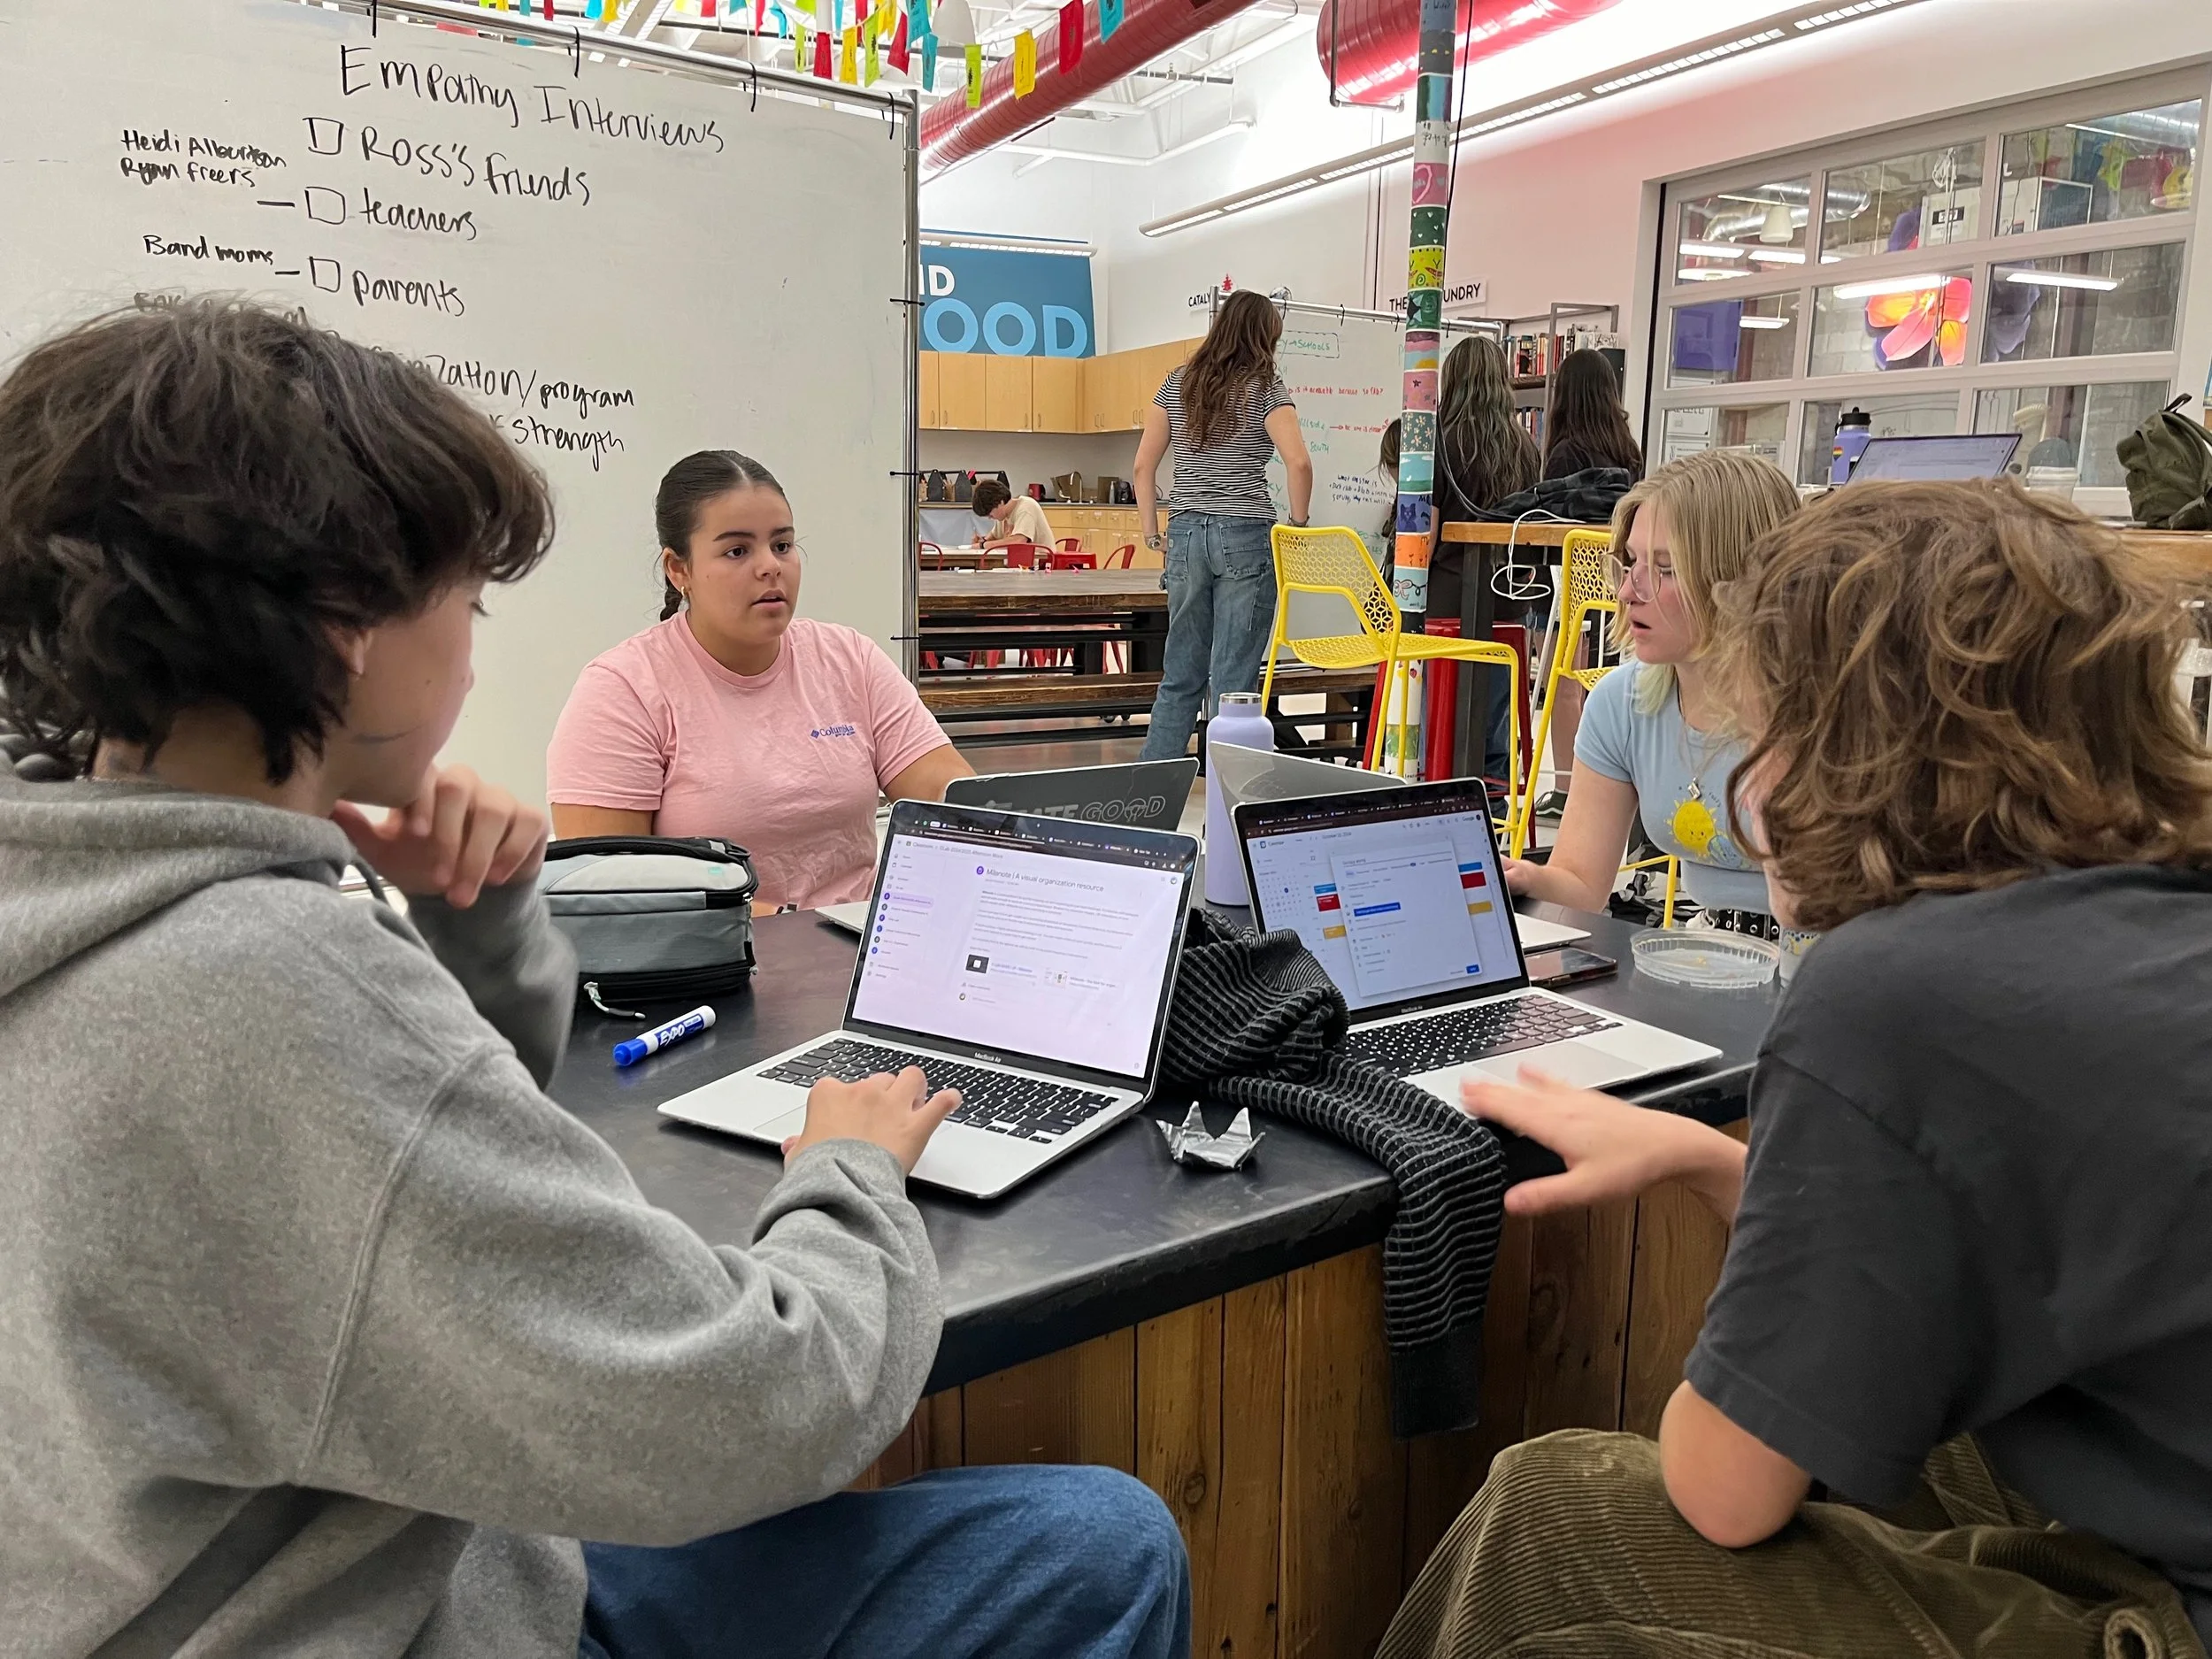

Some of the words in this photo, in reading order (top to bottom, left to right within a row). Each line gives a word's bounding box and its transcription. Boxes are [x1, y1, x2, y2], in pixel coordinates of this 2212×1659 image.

[341, 44, 519, 128] Empathy
[534, 85, 724, 152] Interviews
[120, 129, 180, 152] Heidi
[362, 127, 475, 187] Ross's
[359, 187, 478, 240] teachers
[142, 234, 210, 259] Band
[352, 269, 465, 317] parents
[1389, 296, 1408, 311] THE
[1443, 282, 1481, 303] UNDRY
[923, 297, 1088, 359] OOD
[512, 414, 625, 472] strength
[1021, 872, 1038, 882] visual
[1038, 876, 1076, 889] organization
[1076, 881, 1104, 893] resource
[659, 1023, 686, 1047] EXPO
